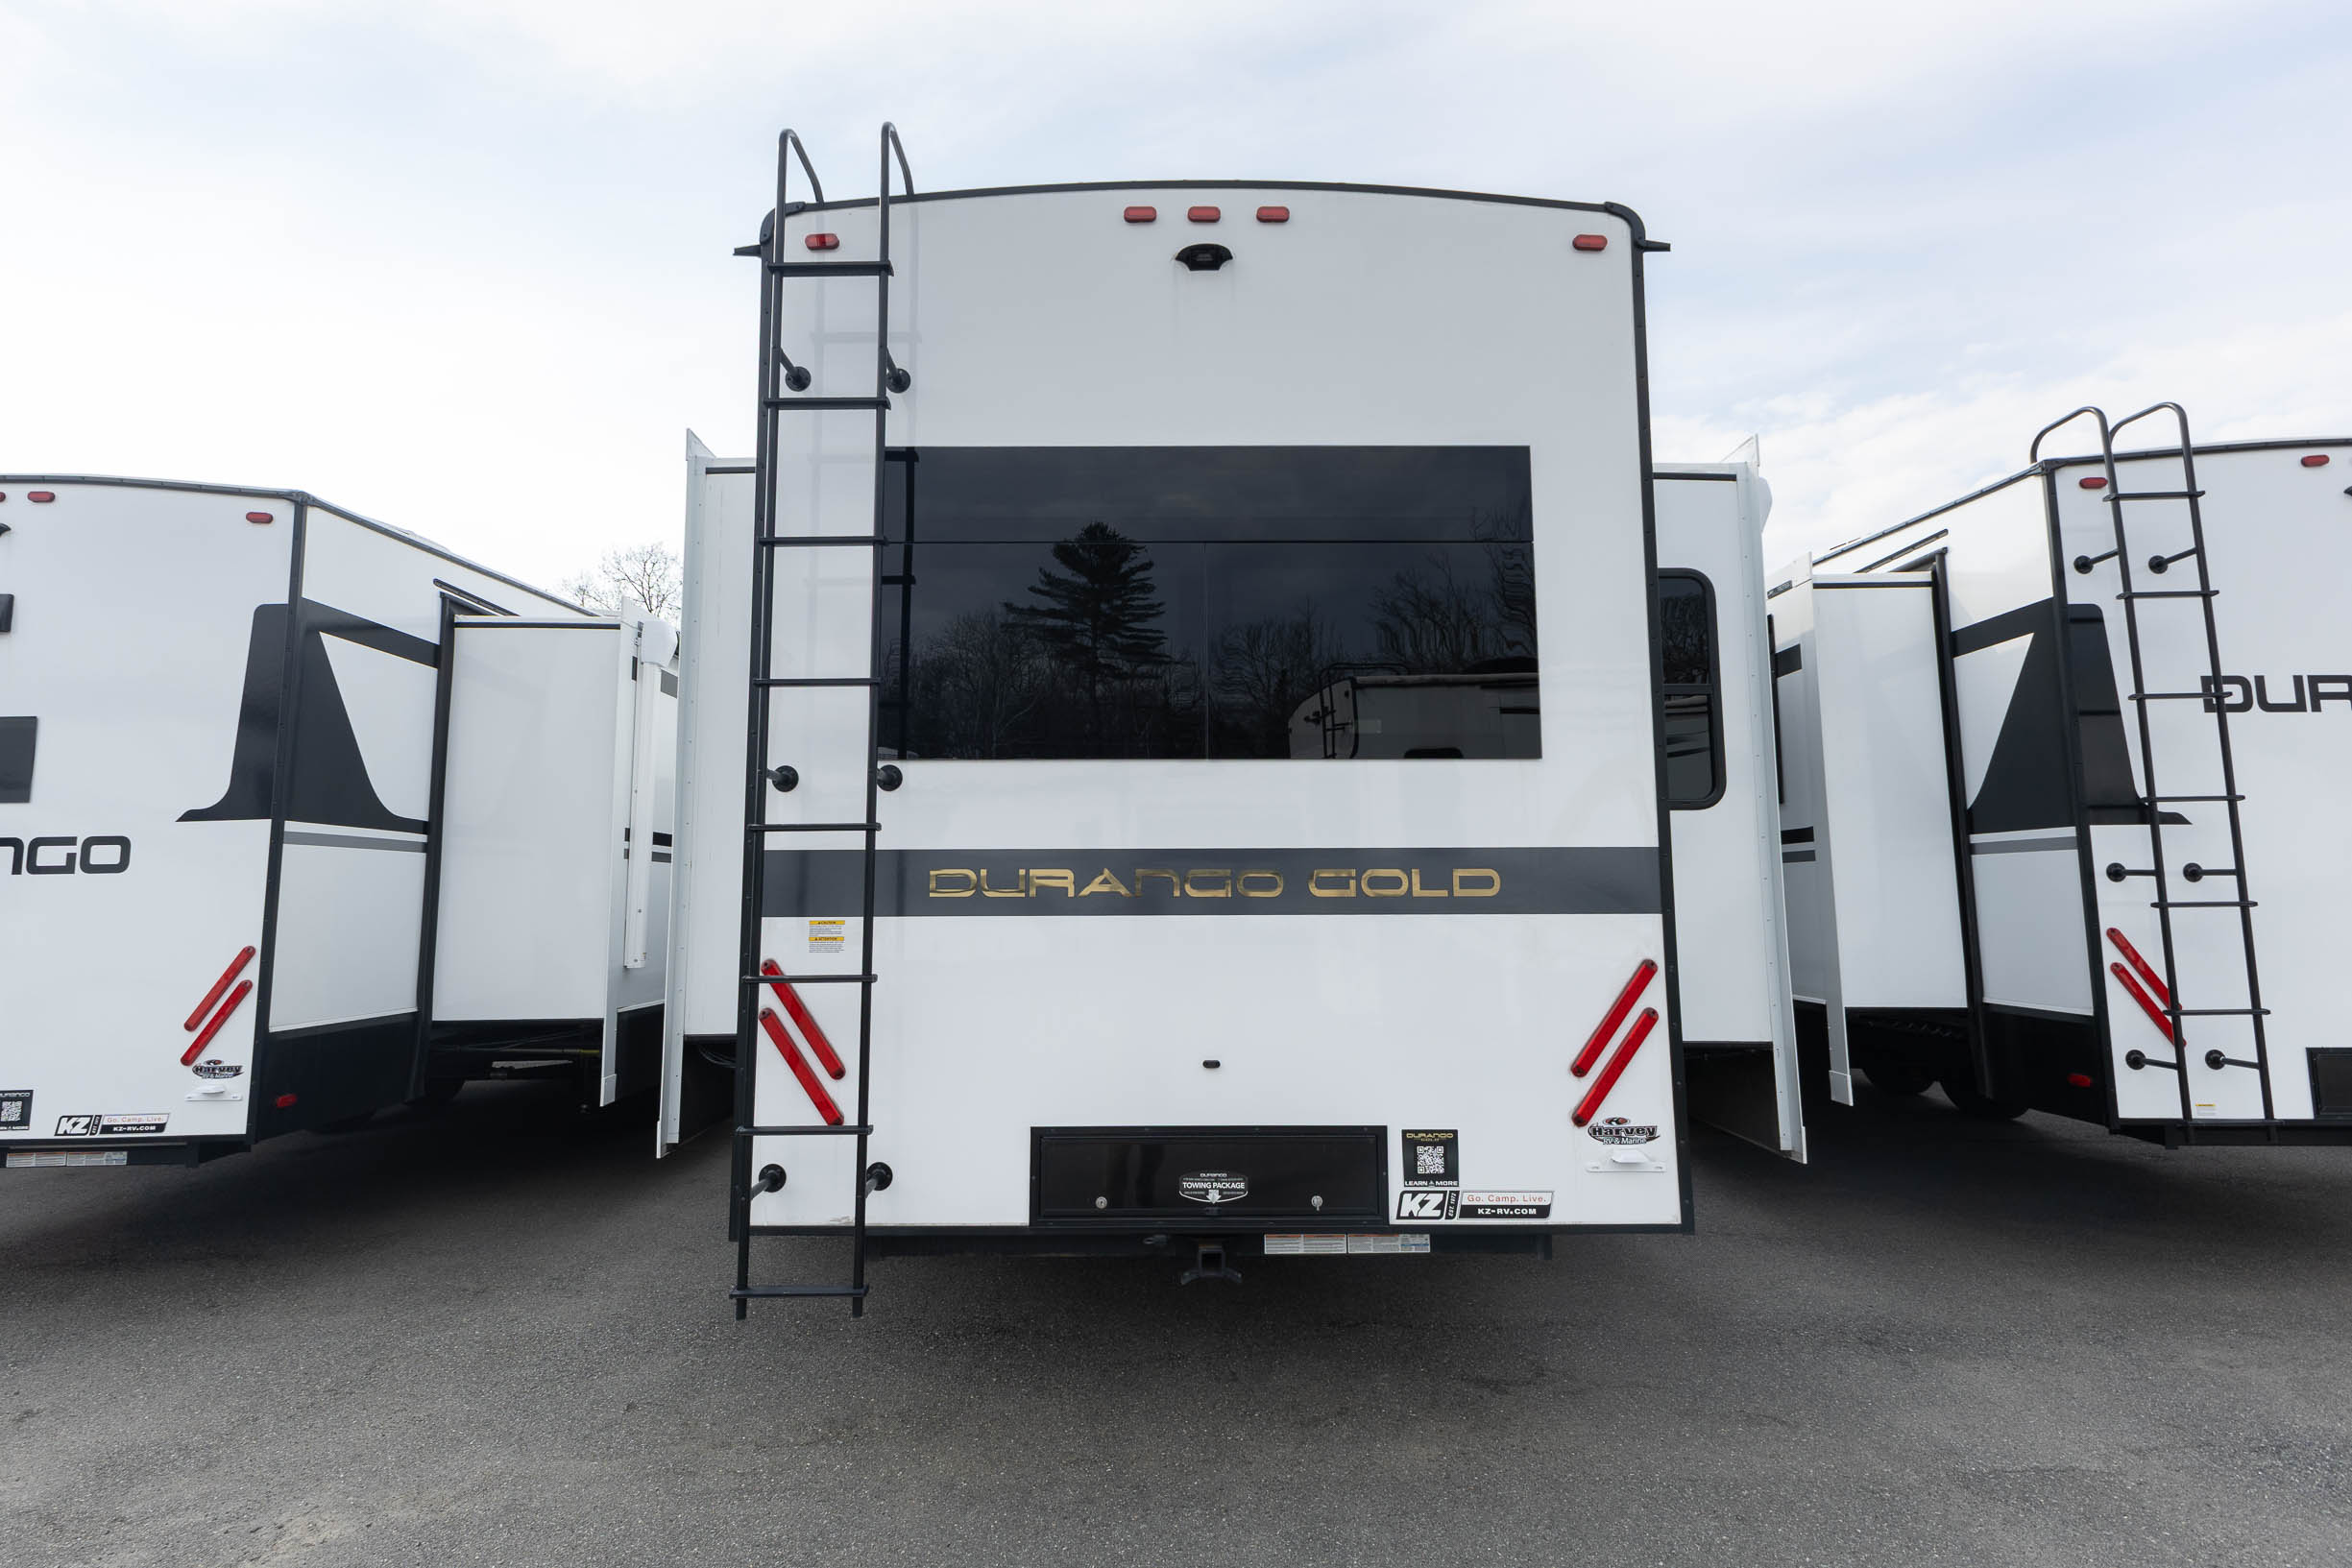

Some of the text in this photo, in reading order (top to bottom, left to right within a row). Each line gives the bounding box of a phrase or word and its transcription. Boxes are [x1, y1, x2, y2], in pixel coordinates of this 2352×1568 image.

[929, 868, 1501, 898] DURANGO GOLD
[57, 1117, 91, 1134] KZ
[1591, 1125, 1658, 1138] Harvey
[1399, 1193, 1444, 1218] KZ
[1488, 1194, 1518, 1204] Camp.
